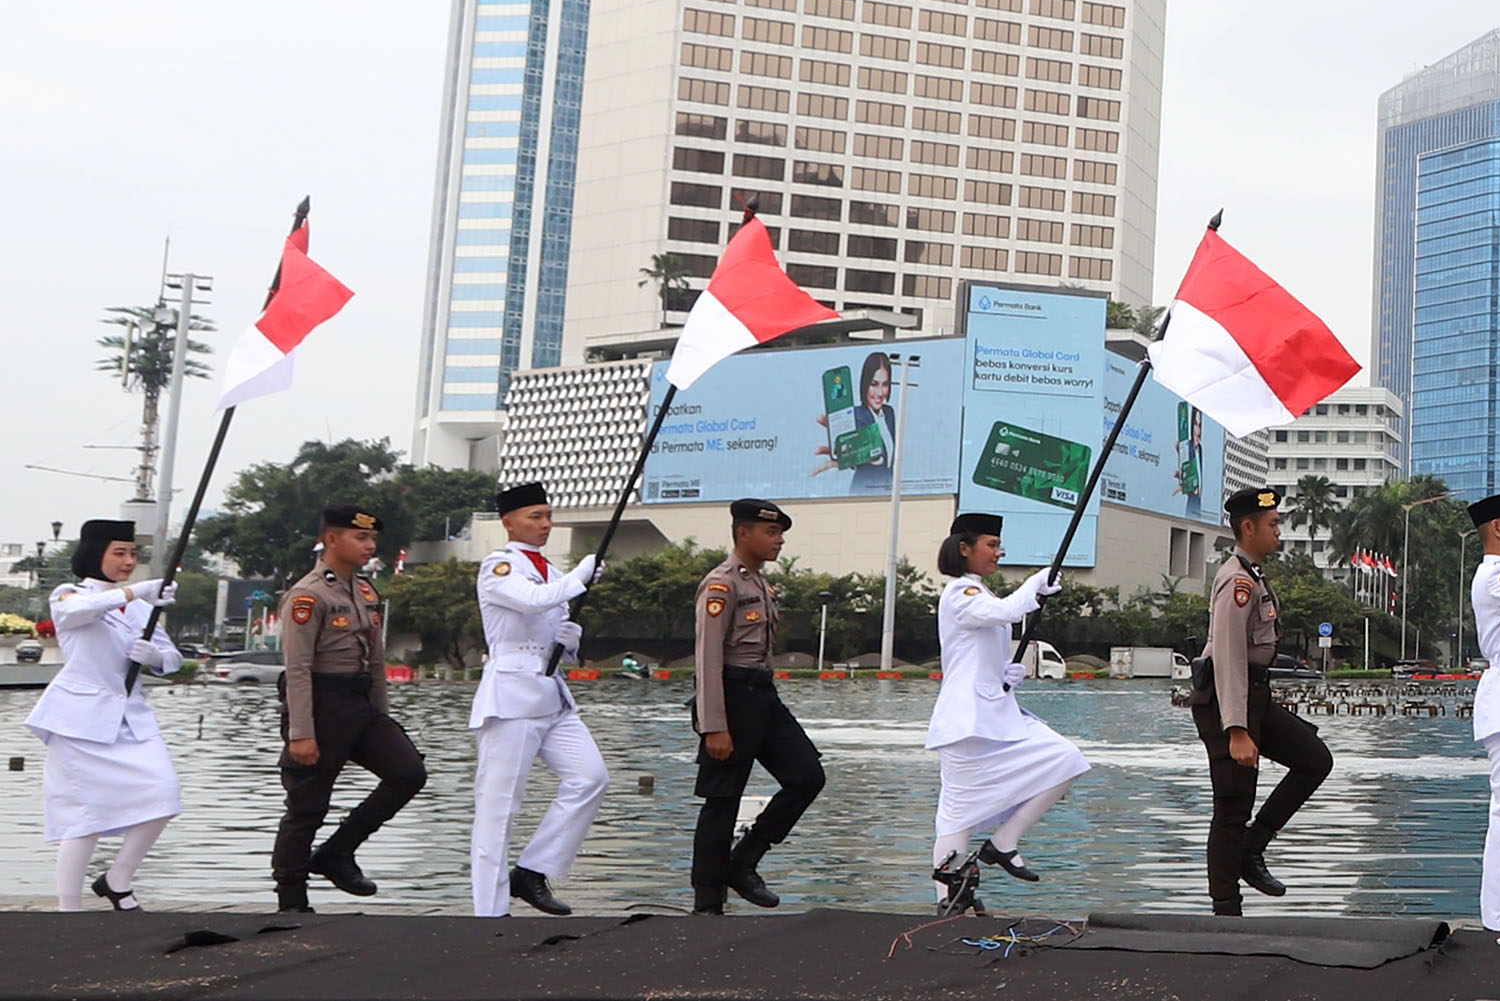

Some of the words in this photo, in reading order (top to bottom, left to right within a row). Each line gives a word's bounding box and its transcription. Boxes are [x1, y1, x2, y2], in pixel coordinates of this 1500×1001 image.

[993, 300, 1023, 310] Permata
[1024, 303, 1042, 311] Bank
[976, 346, 1019, 358] Permata
[1021, 348, 1053, 360] Global
[1056, 350, 1080, 361] Card
[975, 359, 1007, 368] bebas
[1008, 360, 1050, 371] konversi
[1052, 363, 1073, 373] kurs
[975, 371, 1002, 381] kartu
[1003, 373, 1029, 383] debit
[1031, 375, 1062, 385] bebas
[1063, 379, 1094, 389] worry!
[653, 403, 702, 418] Dpatkan
[657, 421, 694, 435] ermata
[696, 420, 728, 433] Global
[730, 418, 756, 431] Card
[662, 441, 704, 454] Permata
[706, 439, 725, 452] ME,
[726, 435, 778, 451] sekarang!
[1055, 489, 1075, 502] VISA
